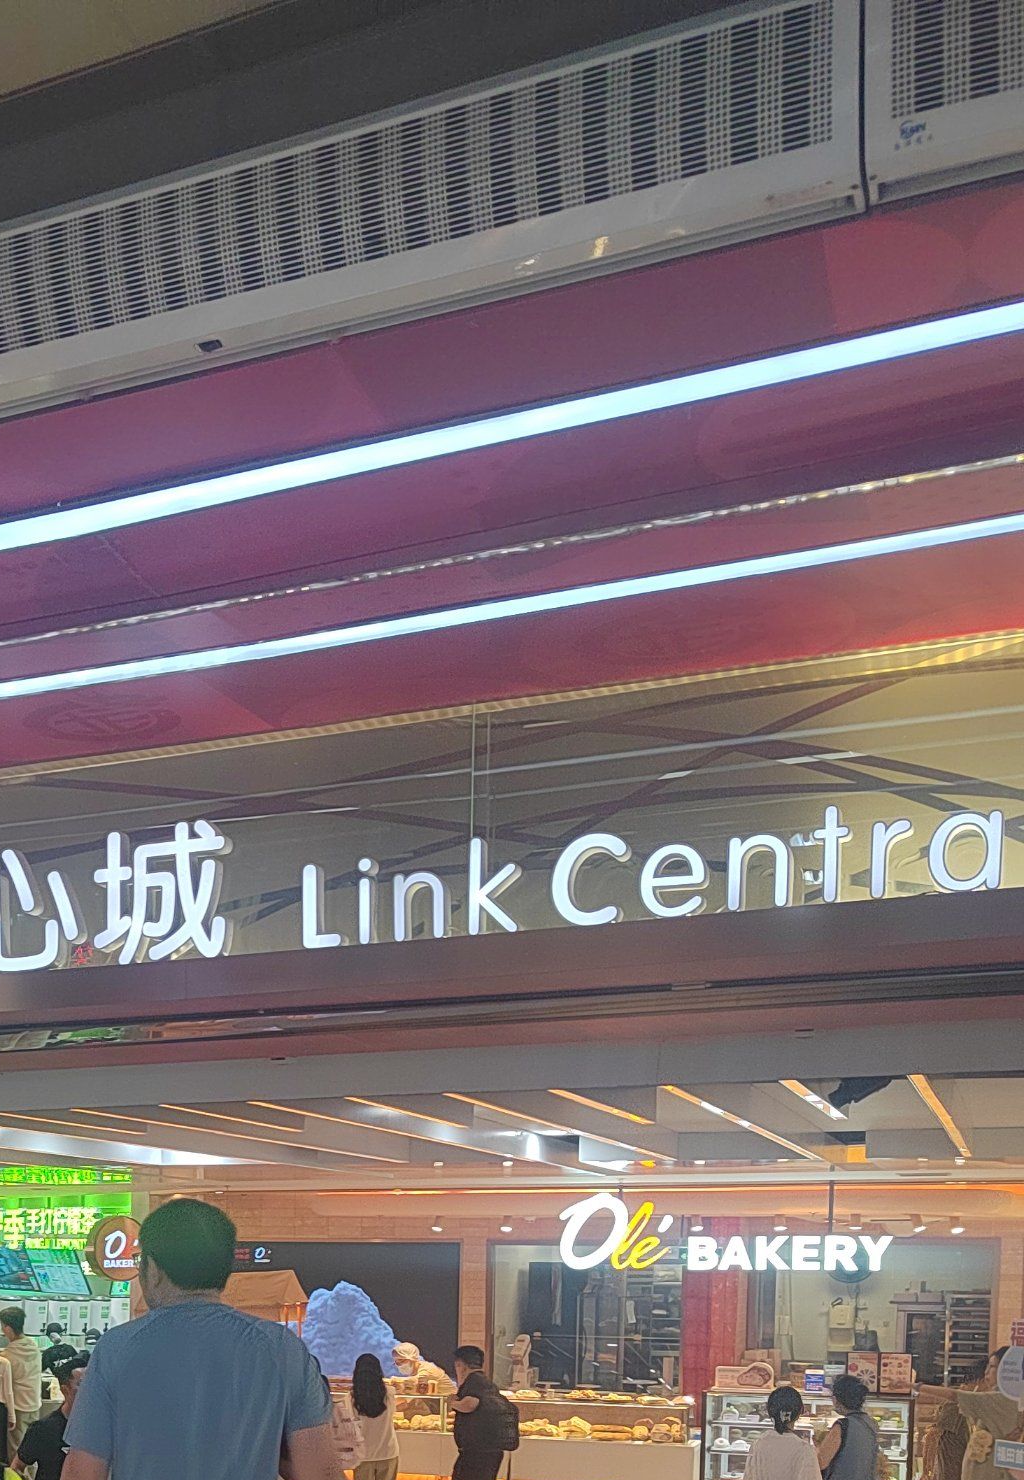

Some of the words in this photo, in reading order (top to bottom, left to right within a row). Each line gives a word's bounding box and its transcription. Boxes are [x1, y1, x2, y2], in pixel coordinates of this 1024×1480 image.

[301, 837, 518, 949] Link
[551, 804, 1004, 927] Centra
[103, 1259, 136, 1268] BAKER
[559, 1191, 674, 1271] Olé
[687, 1235, 895, 1272] BAKERY
